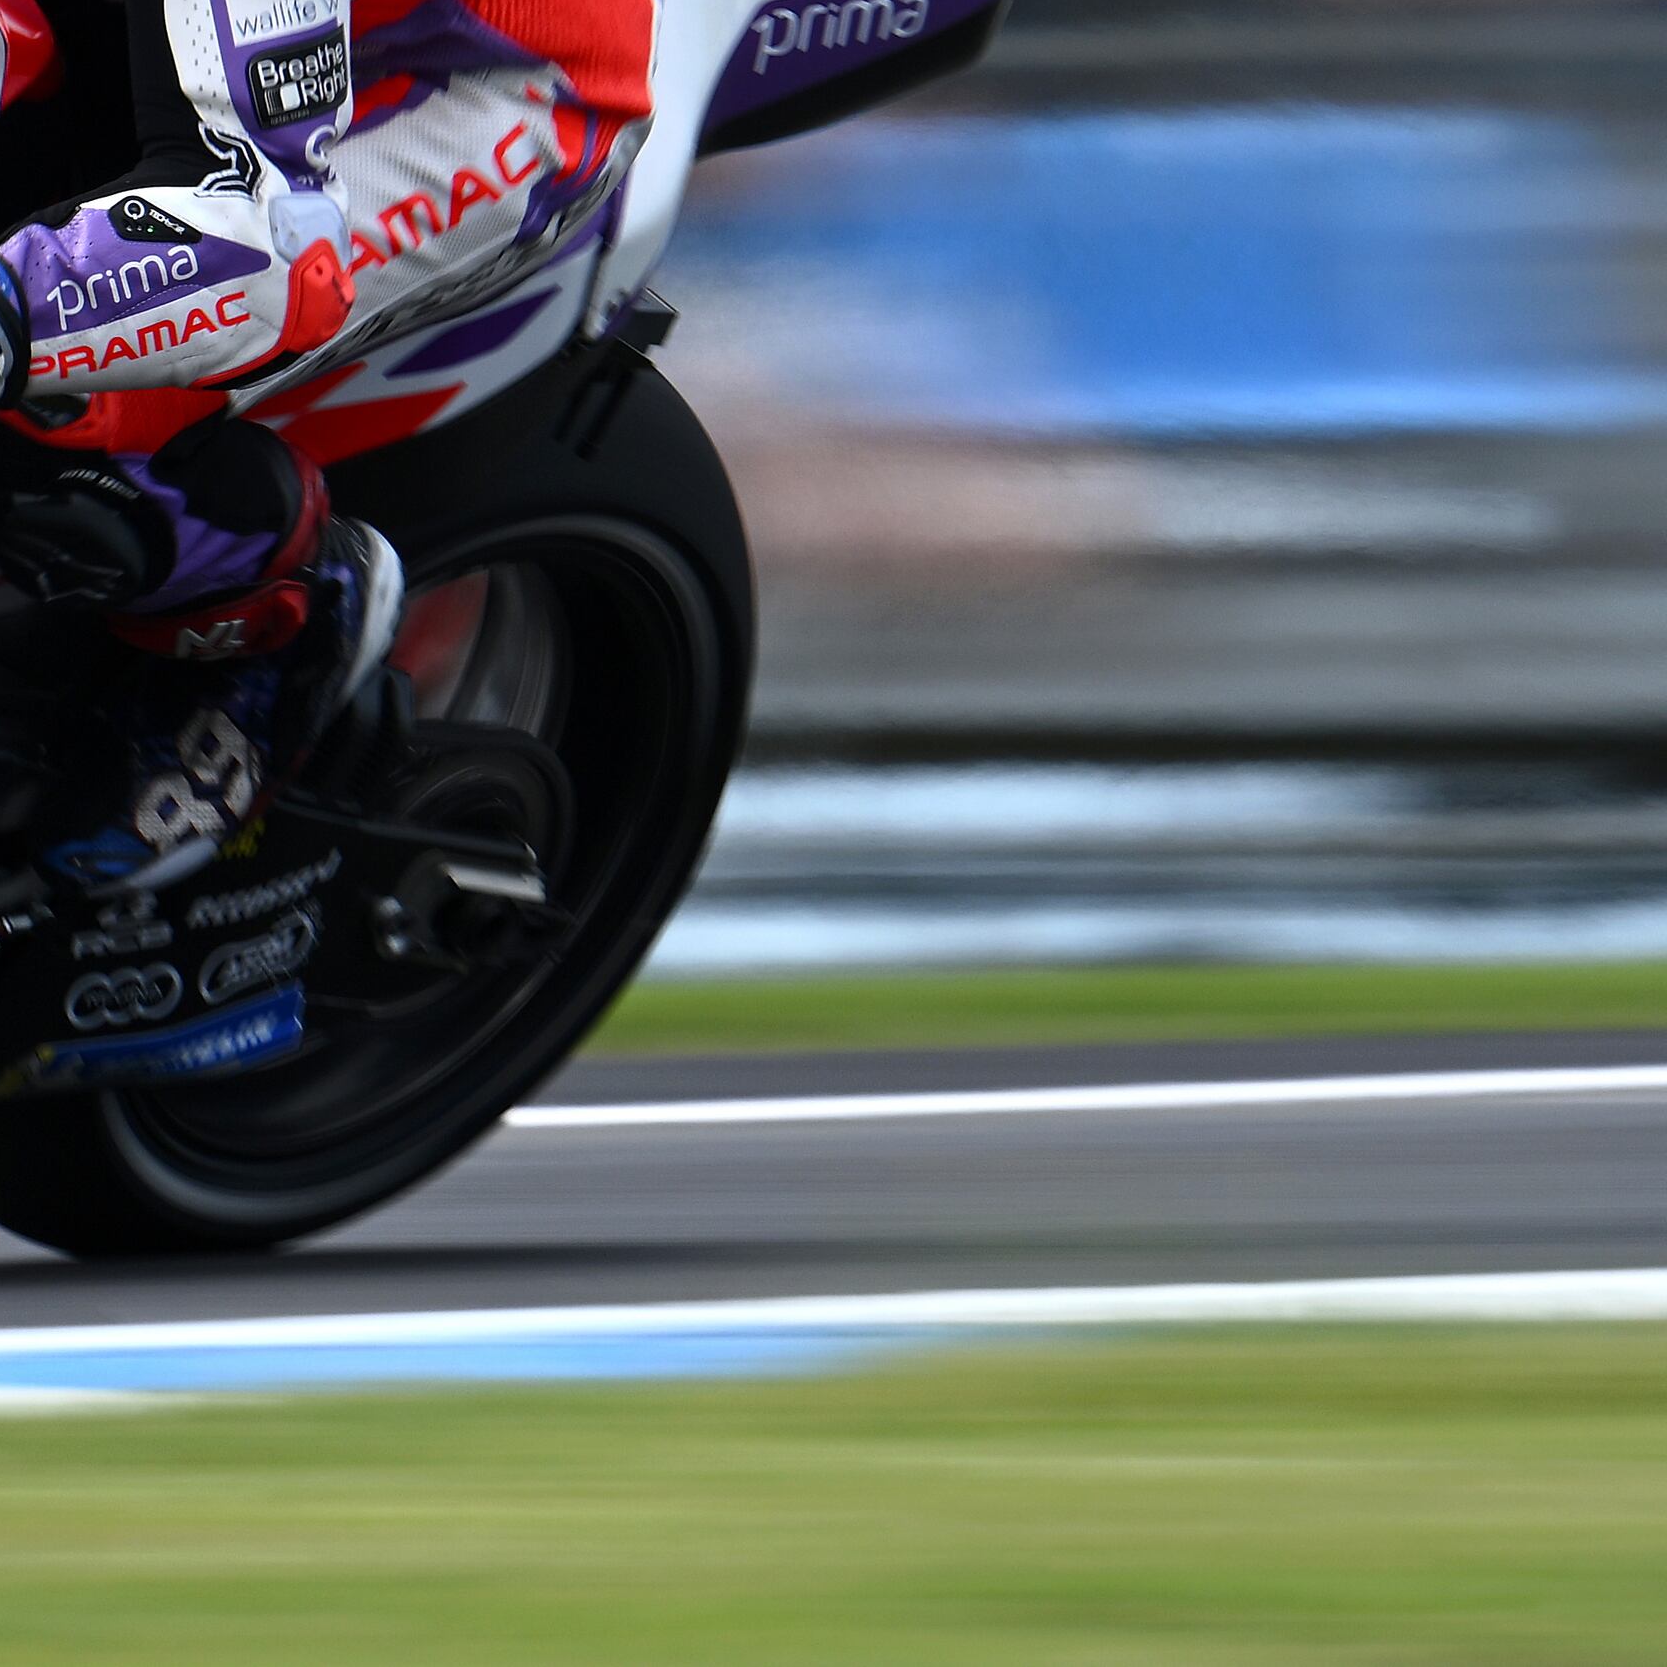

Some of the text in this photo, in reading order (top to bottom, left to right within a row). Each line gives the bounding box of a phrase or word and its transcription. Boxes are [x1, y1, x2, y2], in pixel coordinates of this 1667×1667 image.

[256, 41, 345, 89] Breathe
[300, 64, 348, 107] Right
[346, 119, 549, 276] AMAC
[46, 244, 199, 332] prima
[27, 290, 252, 380] PRAMAC
